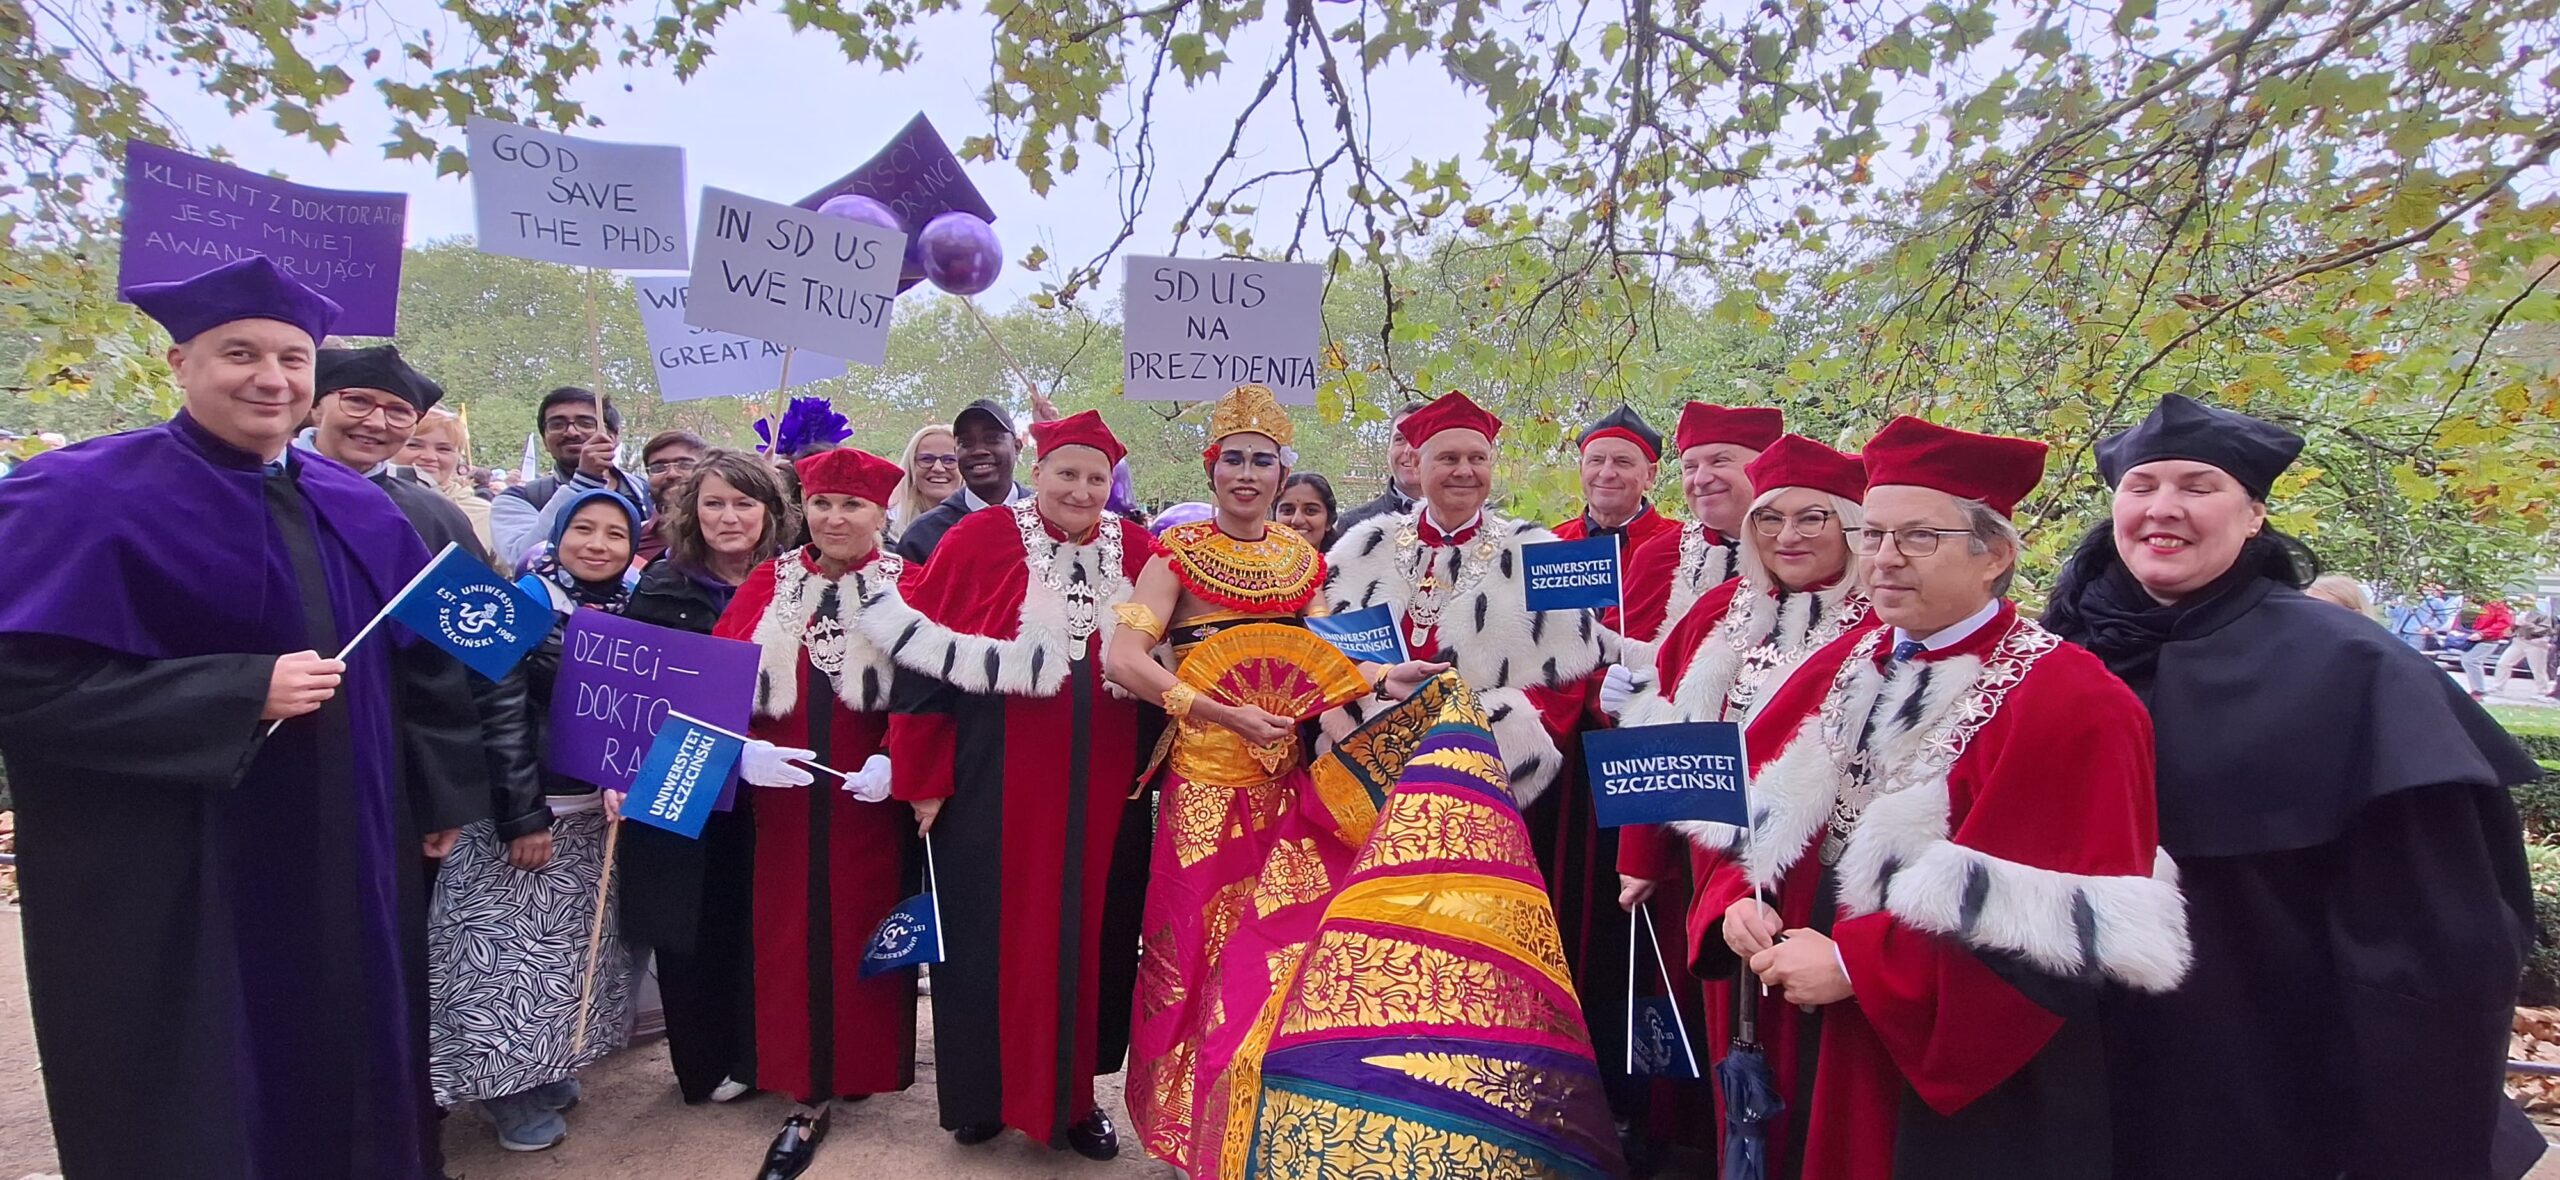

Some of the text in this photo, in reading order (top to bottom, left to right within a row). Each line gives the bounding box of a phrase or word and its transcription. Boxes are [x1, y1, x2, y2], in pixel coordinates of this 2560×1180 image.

[492, 134, 579, 173] GOD
[268, 193, 281, 214] Z
[547, 176, 637, 212] SAVE
[171, 204, 245, 230] JEST
[510, 211, 581, 247] THE
[716, 205, 882, 270] IN SD US
[722, 260, 894, 328] WE TRUST
[1154, 267, 1266, 308] SD US
[1187, 315, 1229, 341] NA
[659, 340, 751, 369] GREAT
[1130, 352, 1317, 390] PREZYDENTA
[1531, 559, 1612, 576] UNIWERSYTET
[1532, 572, 1612, 590] SZCZECIŃSKI
[436, 587, 458, 606] EST.
[461, 584, 515, 626] UNIWERSYTET
[439, 607, 494, 648] SZCZECIŃSKI
[495, 627, 517, 643] 1985
[649, 728, 701, 816] UNIWERSYTET
[664, 735, 716, 821] SZCZECIŃSKI
[1602, 754, 1736, 777] UNIWERSYTET
[1605, 770, 1737, 795] SZCZECIŃSKI
